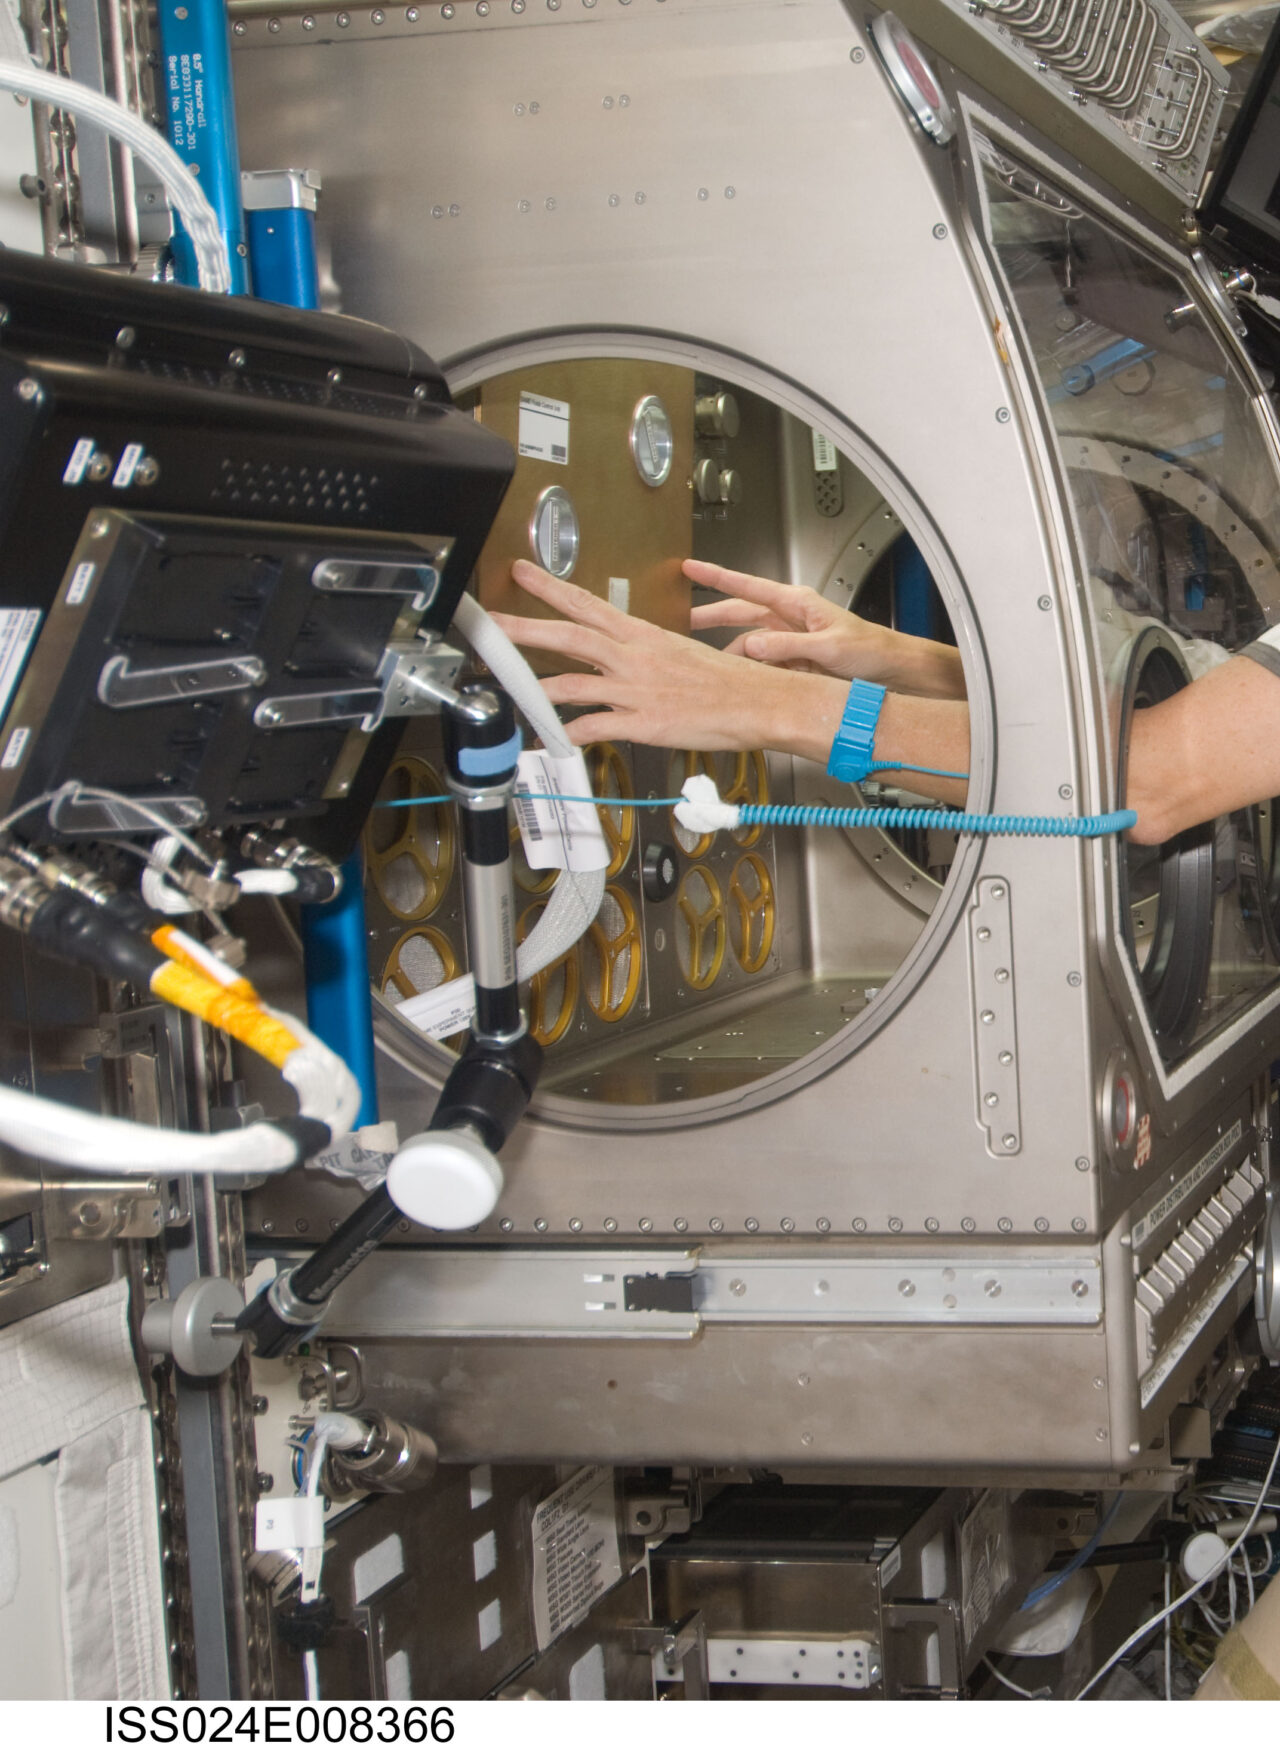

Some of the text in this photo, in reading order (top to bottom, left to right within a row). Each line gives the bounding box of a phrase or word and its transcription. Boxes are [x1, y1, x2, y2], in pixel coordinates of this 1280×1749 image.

[168, 55, 179, 90] Serial
[174, 120, 183, 146] 1012
[195, 80, 207, 128] Handrail
